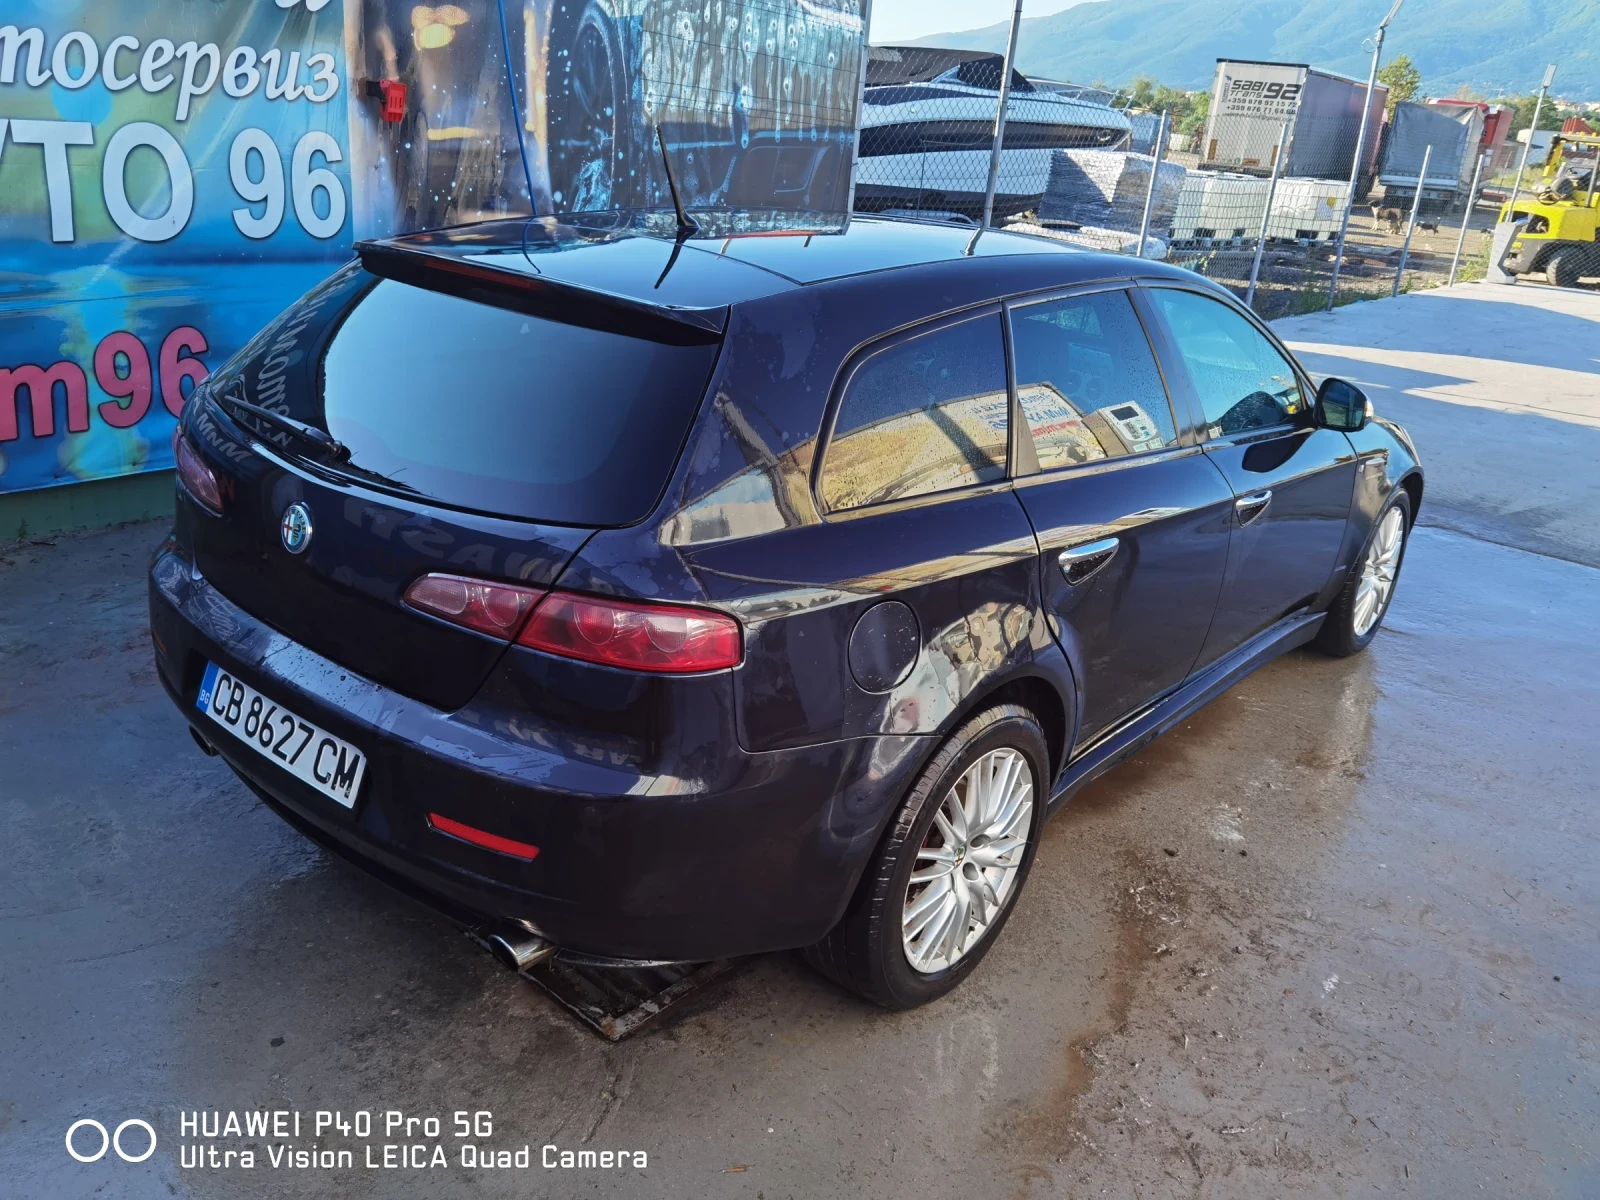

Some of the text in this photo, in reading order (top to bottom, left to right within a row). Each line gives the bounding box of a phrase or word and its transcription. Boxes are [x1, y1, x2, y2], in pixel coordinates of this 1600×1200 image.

[1263, 82, 1302, 101] 92
[1226, 104, 1245, 112] +359
[0, 118, 347, 242] ТО 96
[200, 688, 211, 705] BG
[212, 673, 361, 799] CB 8627 CM
